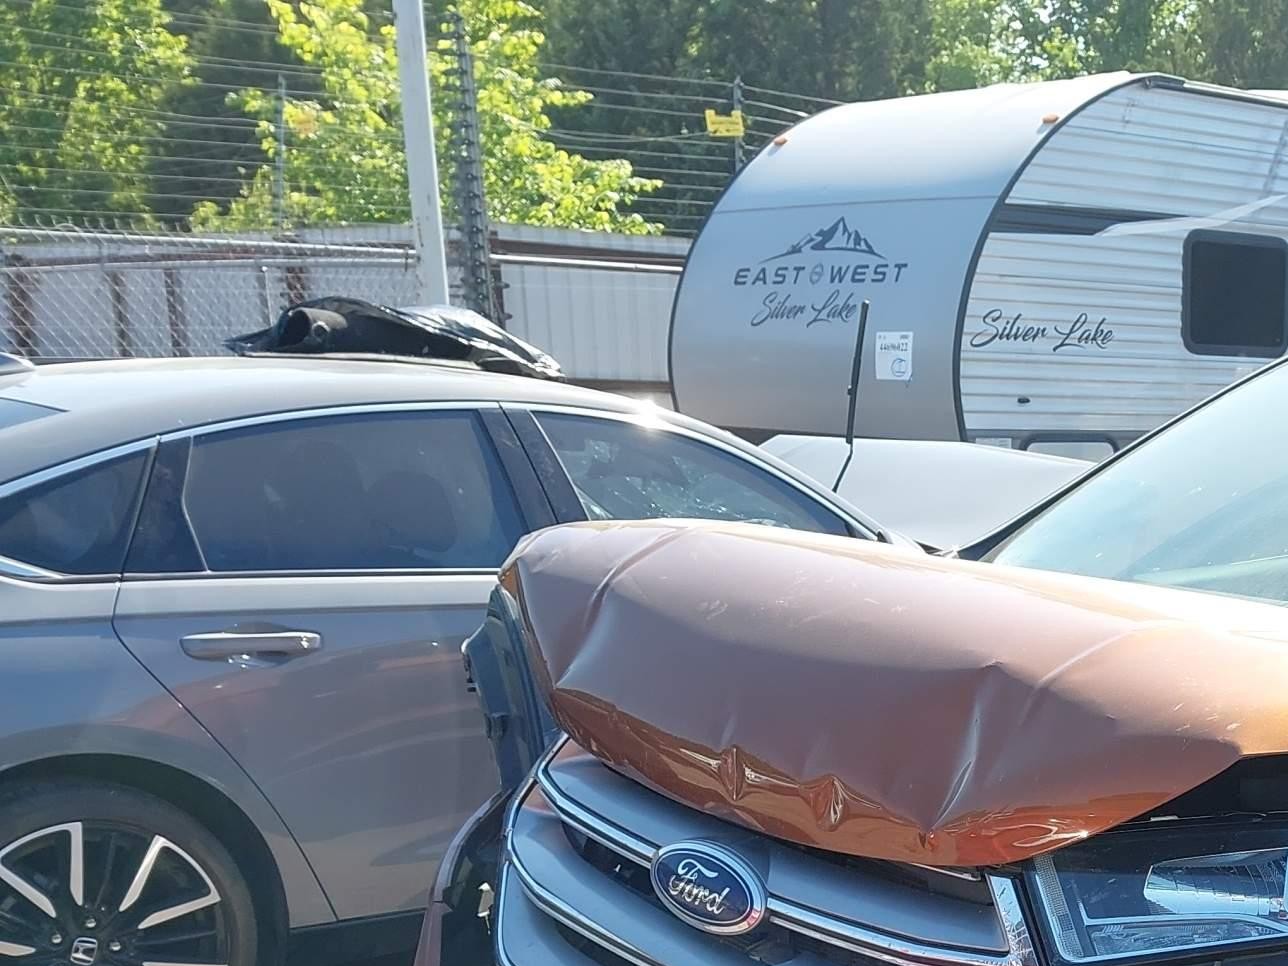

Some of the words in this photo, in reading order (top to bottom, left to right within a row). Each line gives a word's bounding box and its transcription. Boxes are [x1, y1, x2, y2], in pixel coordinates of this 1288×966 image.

[734, 265, 806, 286] EAST
[829, 263, 908, 284] WEST
[750, 291, 806, 327] Silver
[806, 289, 858, 329] Lake
[969, 308, 1048, 348] Silver
[1053, 312, 1115, 352] Lake
[668, 858, 731, 915] Ford
